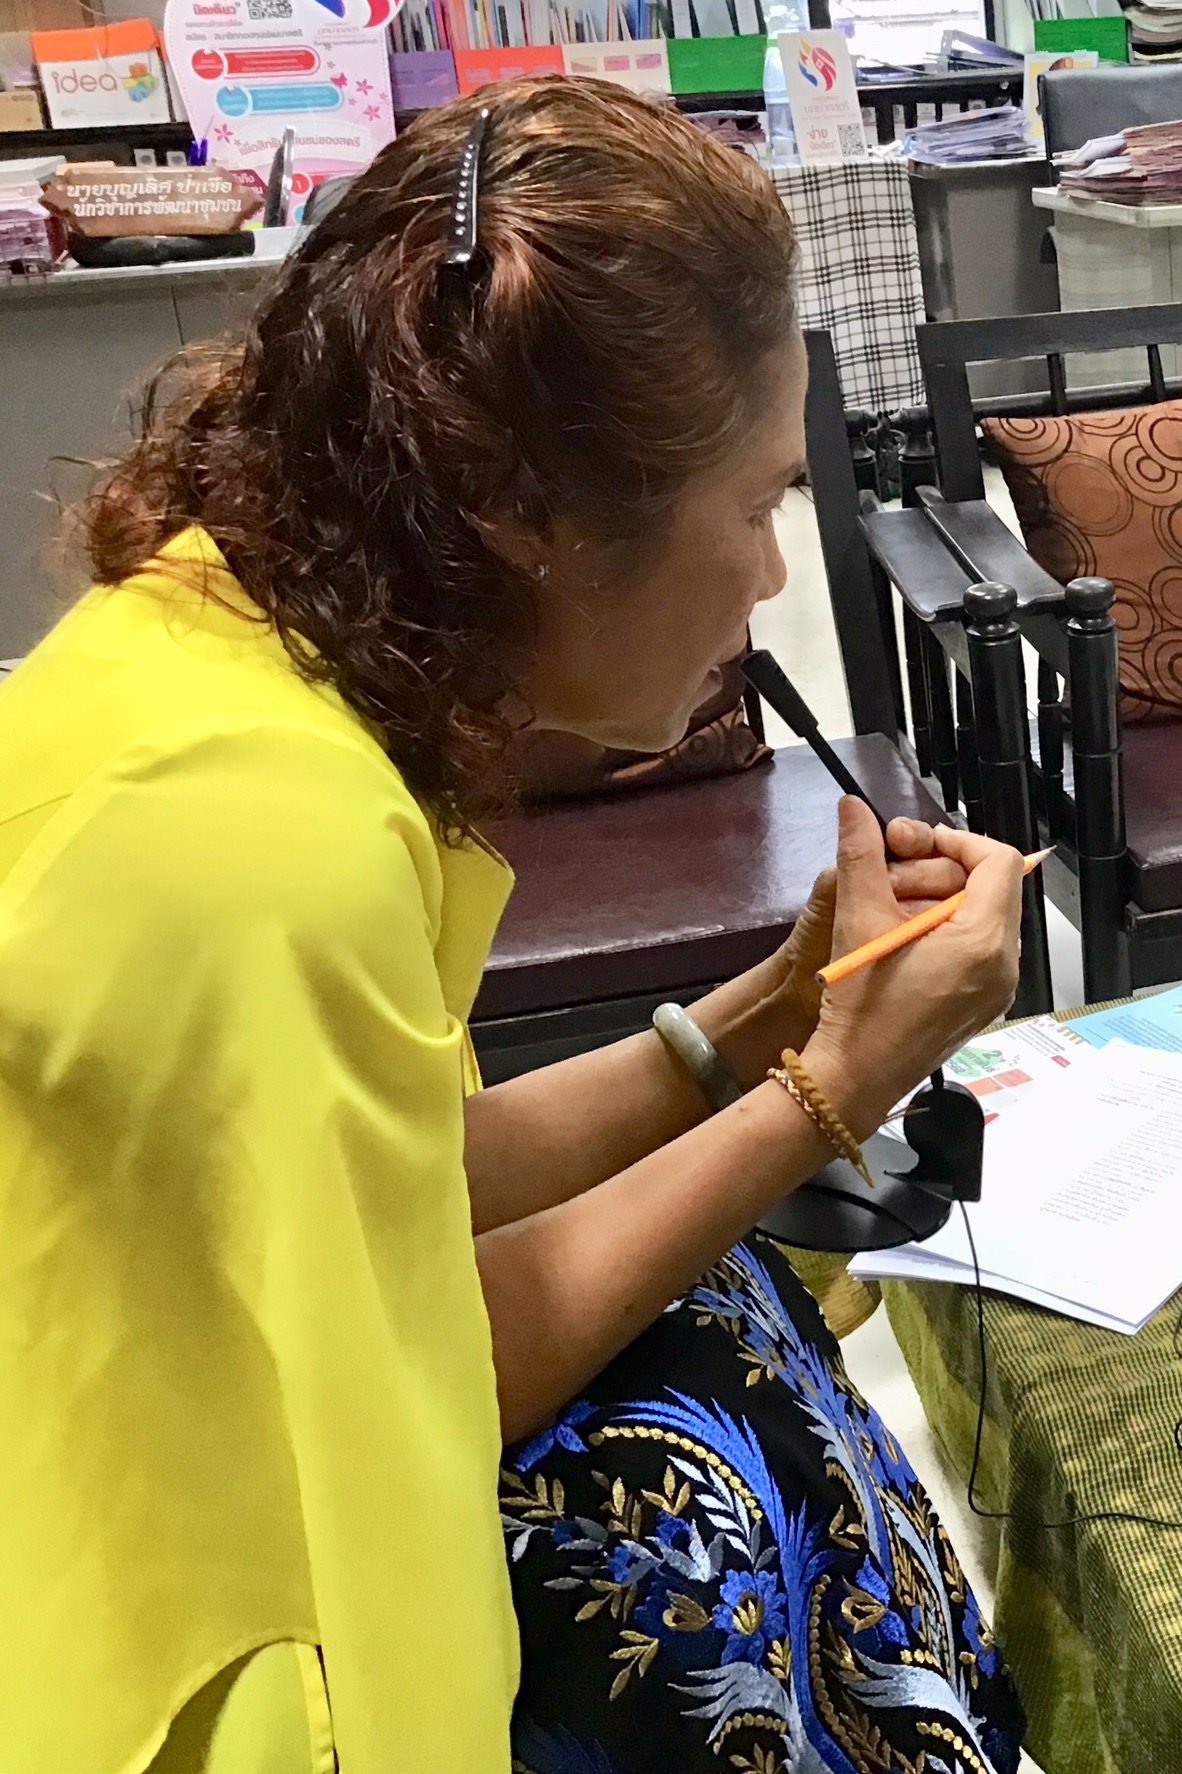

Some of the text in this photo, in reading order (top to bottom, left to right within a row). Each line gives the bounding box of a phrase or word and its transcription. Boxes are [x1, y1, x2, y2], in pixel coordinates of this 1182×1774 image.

[51, 68, 118, 94] idea
[74, 195, 242, 221] นักวิชาการพัฒนาชุมชน
